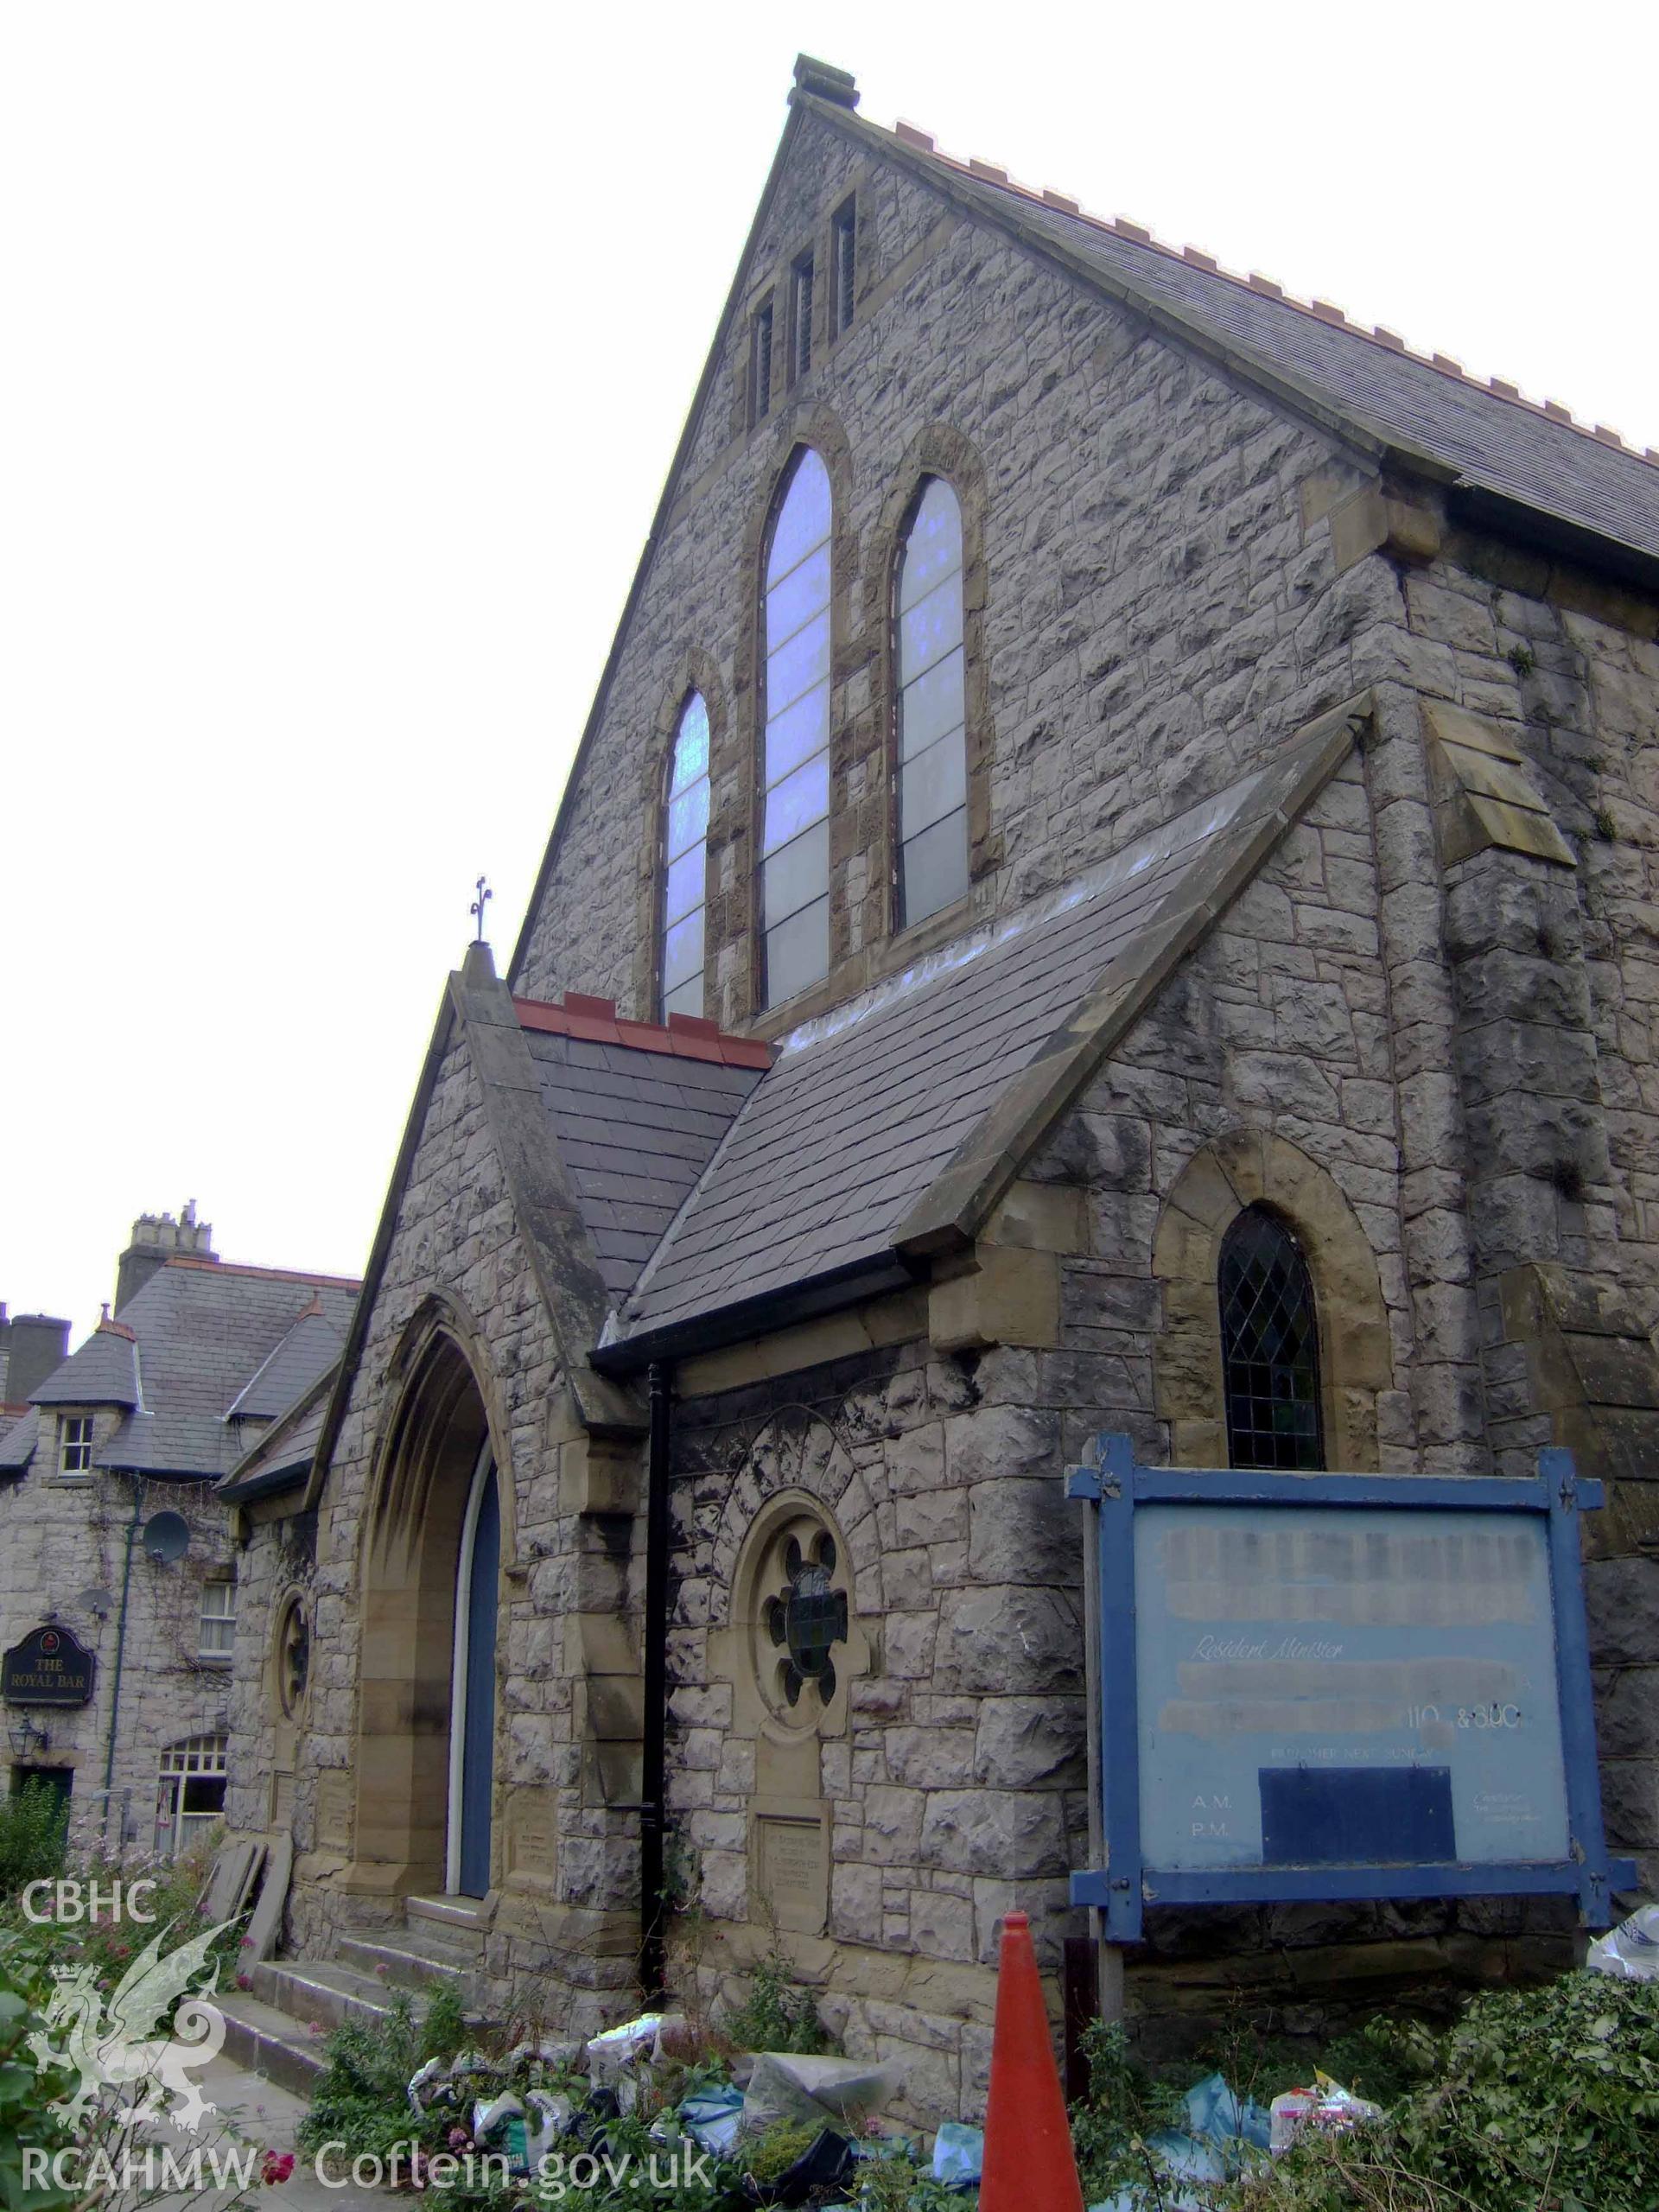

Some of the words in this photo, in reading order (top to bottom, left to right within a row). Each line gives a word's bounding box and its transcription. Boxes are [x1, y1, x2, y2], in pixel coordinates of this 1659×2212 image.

[1192, 1633, 1268, 1660] Resident
[1272, 1636, 1342, 1660] Minister
[36, 1659, 63, 1672] THE
[11, 1674, 54, 1687] ROYAL
[57, 1675, 84, 1688] BAR
